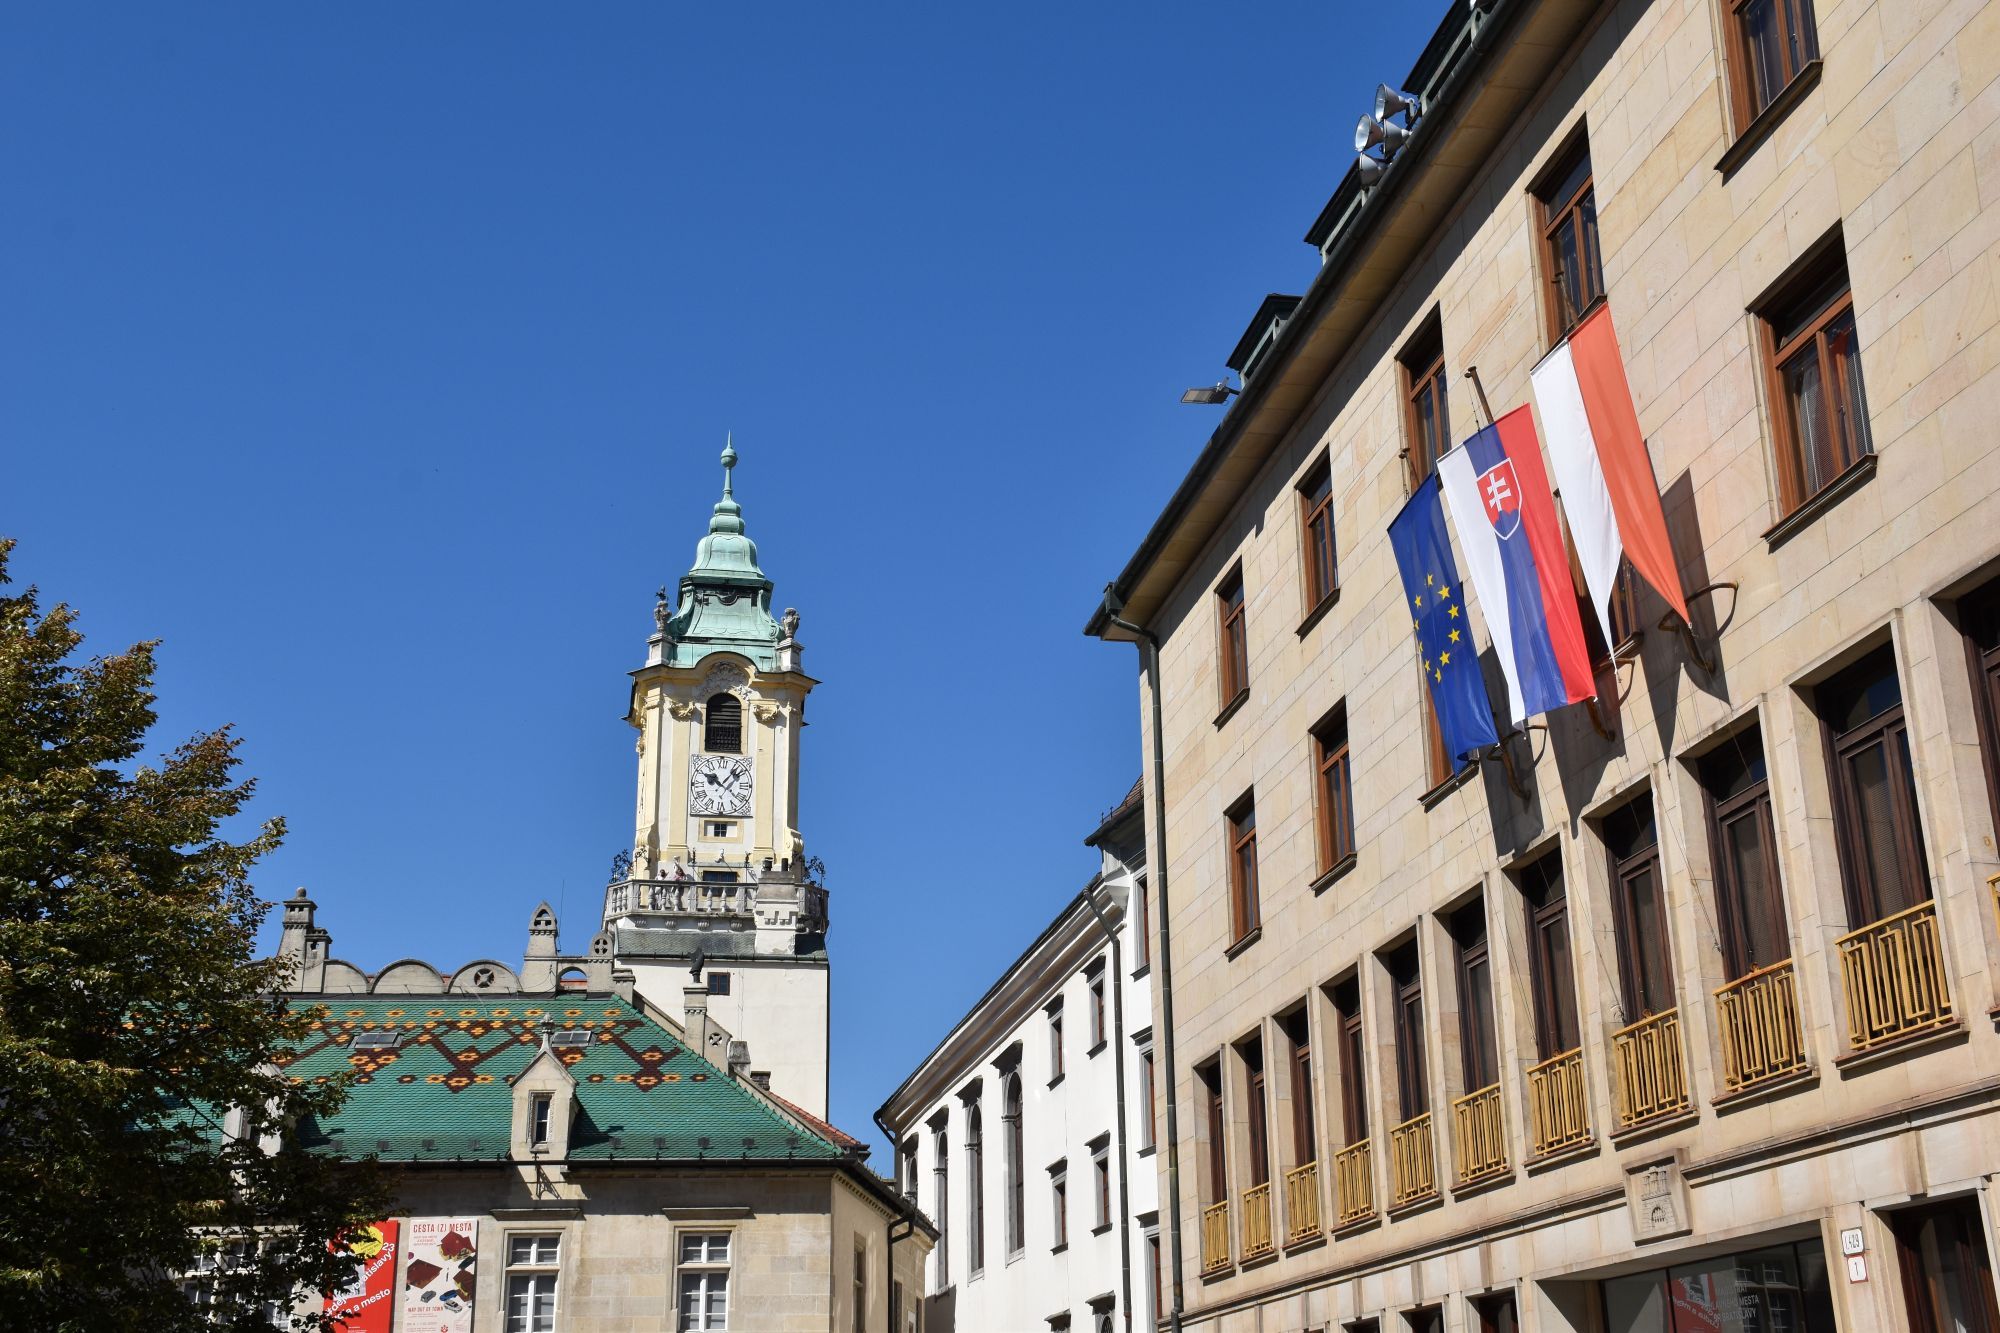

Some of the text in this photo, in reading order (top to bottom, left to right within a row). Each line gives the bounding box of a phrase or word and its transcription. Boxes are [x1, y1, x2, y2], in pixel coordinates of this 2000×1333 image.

[413, 1223, 435, 1233] CESTA
[450, 1223, 472, 1232] MESTA
[353, 1288, 391, 1313] a mesto
